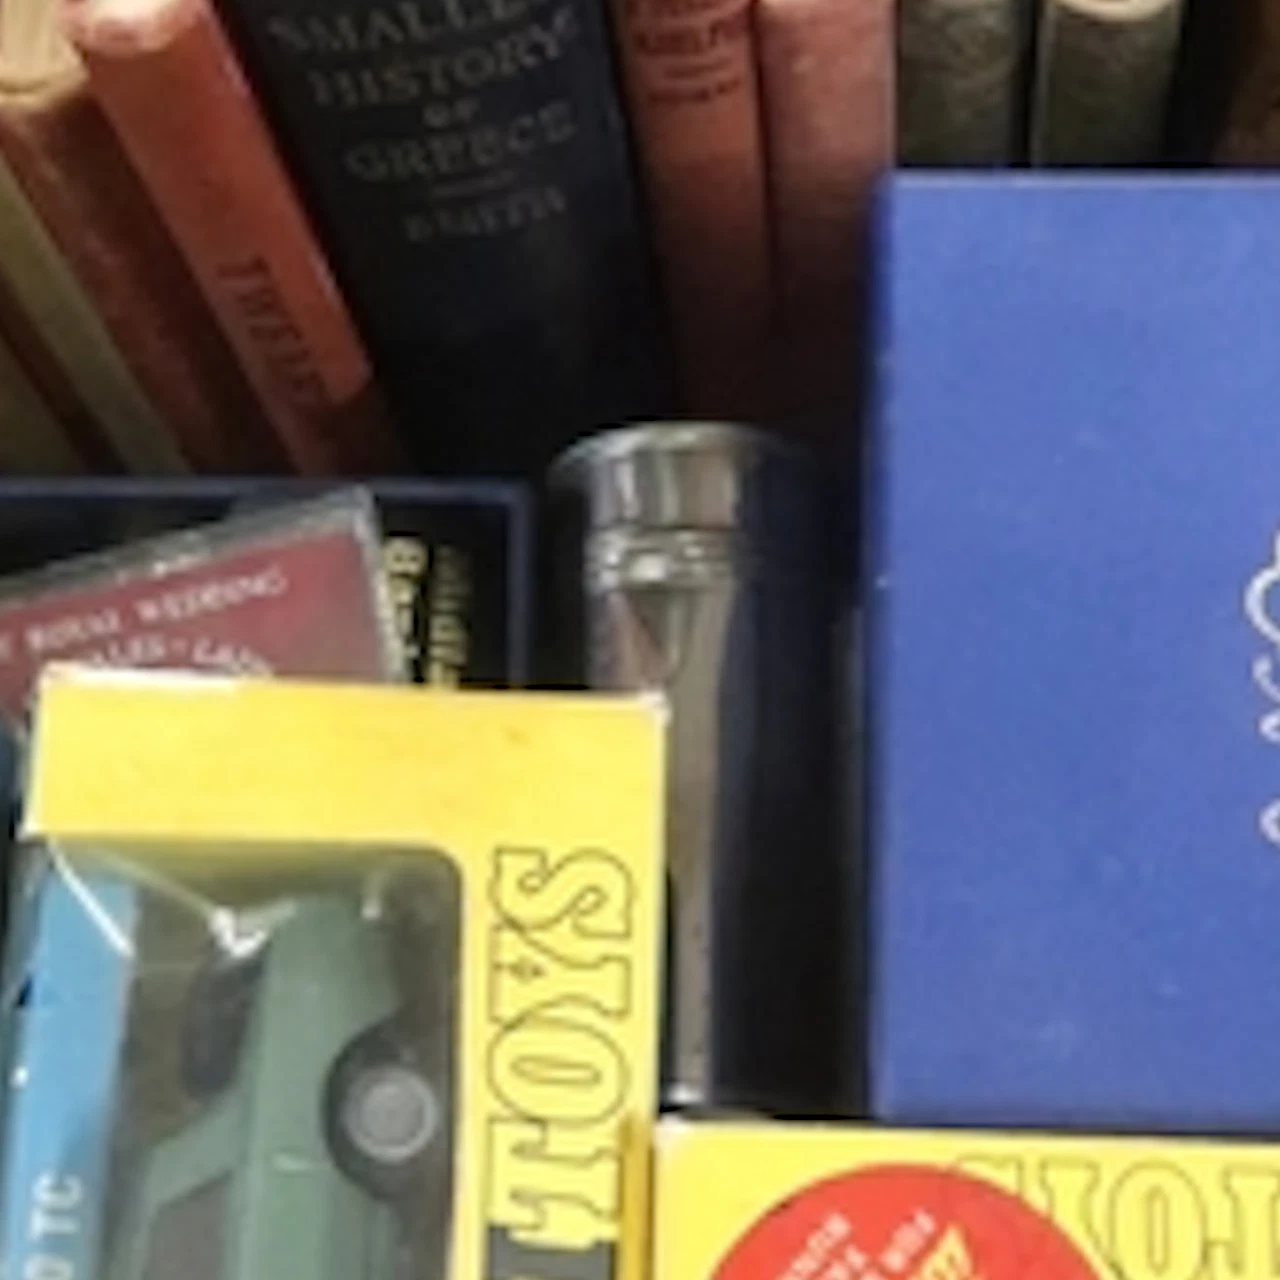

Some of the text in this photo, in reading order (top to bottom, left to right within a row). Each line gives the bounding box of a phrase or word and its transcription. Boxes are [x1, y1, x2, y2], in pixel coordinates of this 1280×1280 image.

[308, 6, 576, 108] HISTORY
[344, 99, 576, 183] GREECE
[32, 1170, 86, 1236] TC
[880, 1208, 938, 1274] FOR
